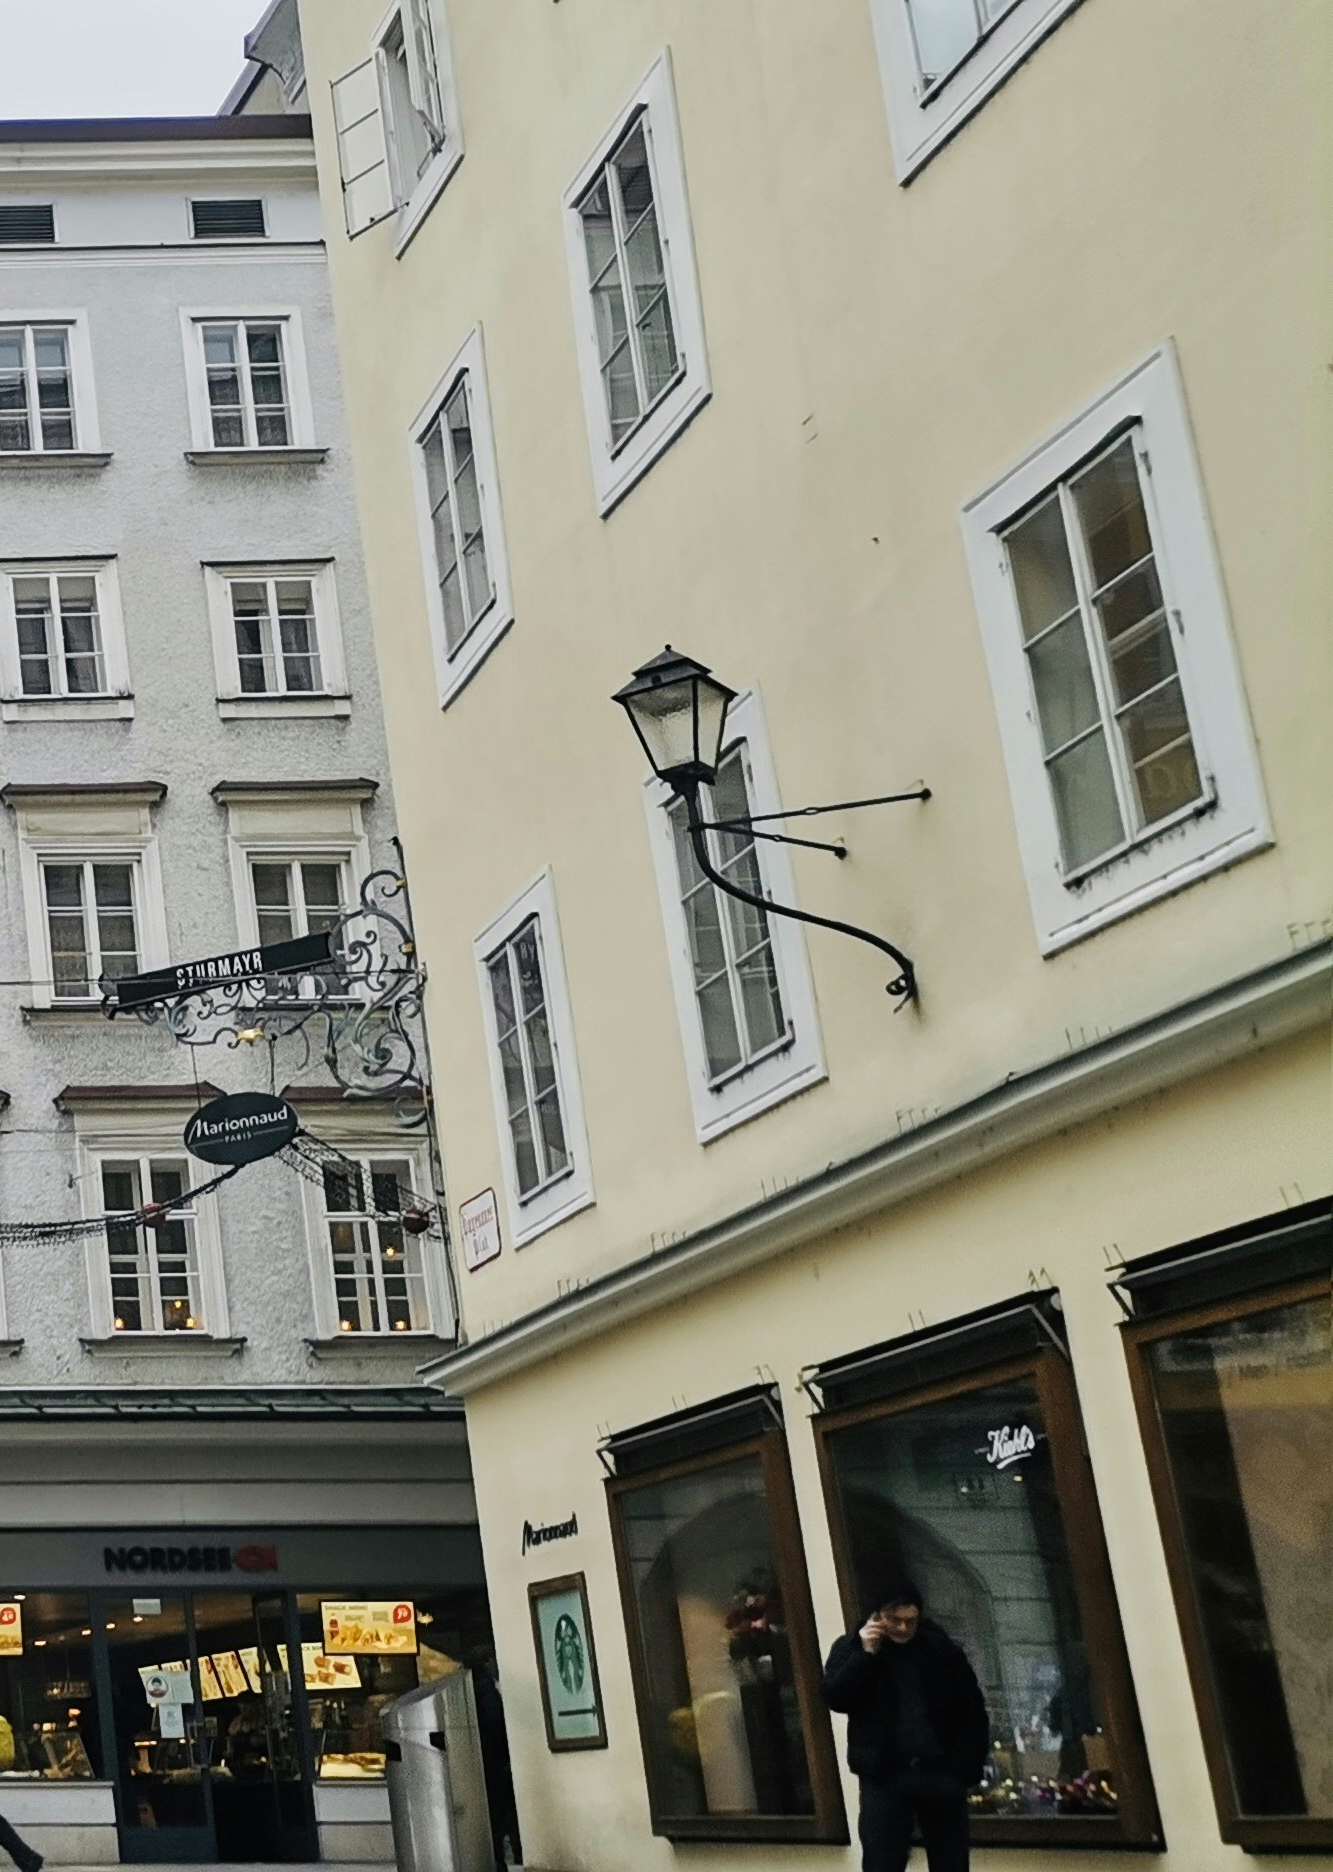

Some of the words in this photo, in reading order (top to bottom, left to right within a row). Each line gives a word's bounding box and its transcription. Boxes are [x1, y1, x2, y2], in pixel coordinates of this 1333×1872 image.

[176, 951, 263, 988] STURMAYR
[187, 1105, 288, 1145] Marionnaud
[224, 1131, 252, 1143] PARIS
[987, 1425, 1035, 1464] Kiehl's
[522, 1511, 578, 1556] Marionnaud
[103, 1546, 232, 1573] NORDSEE
